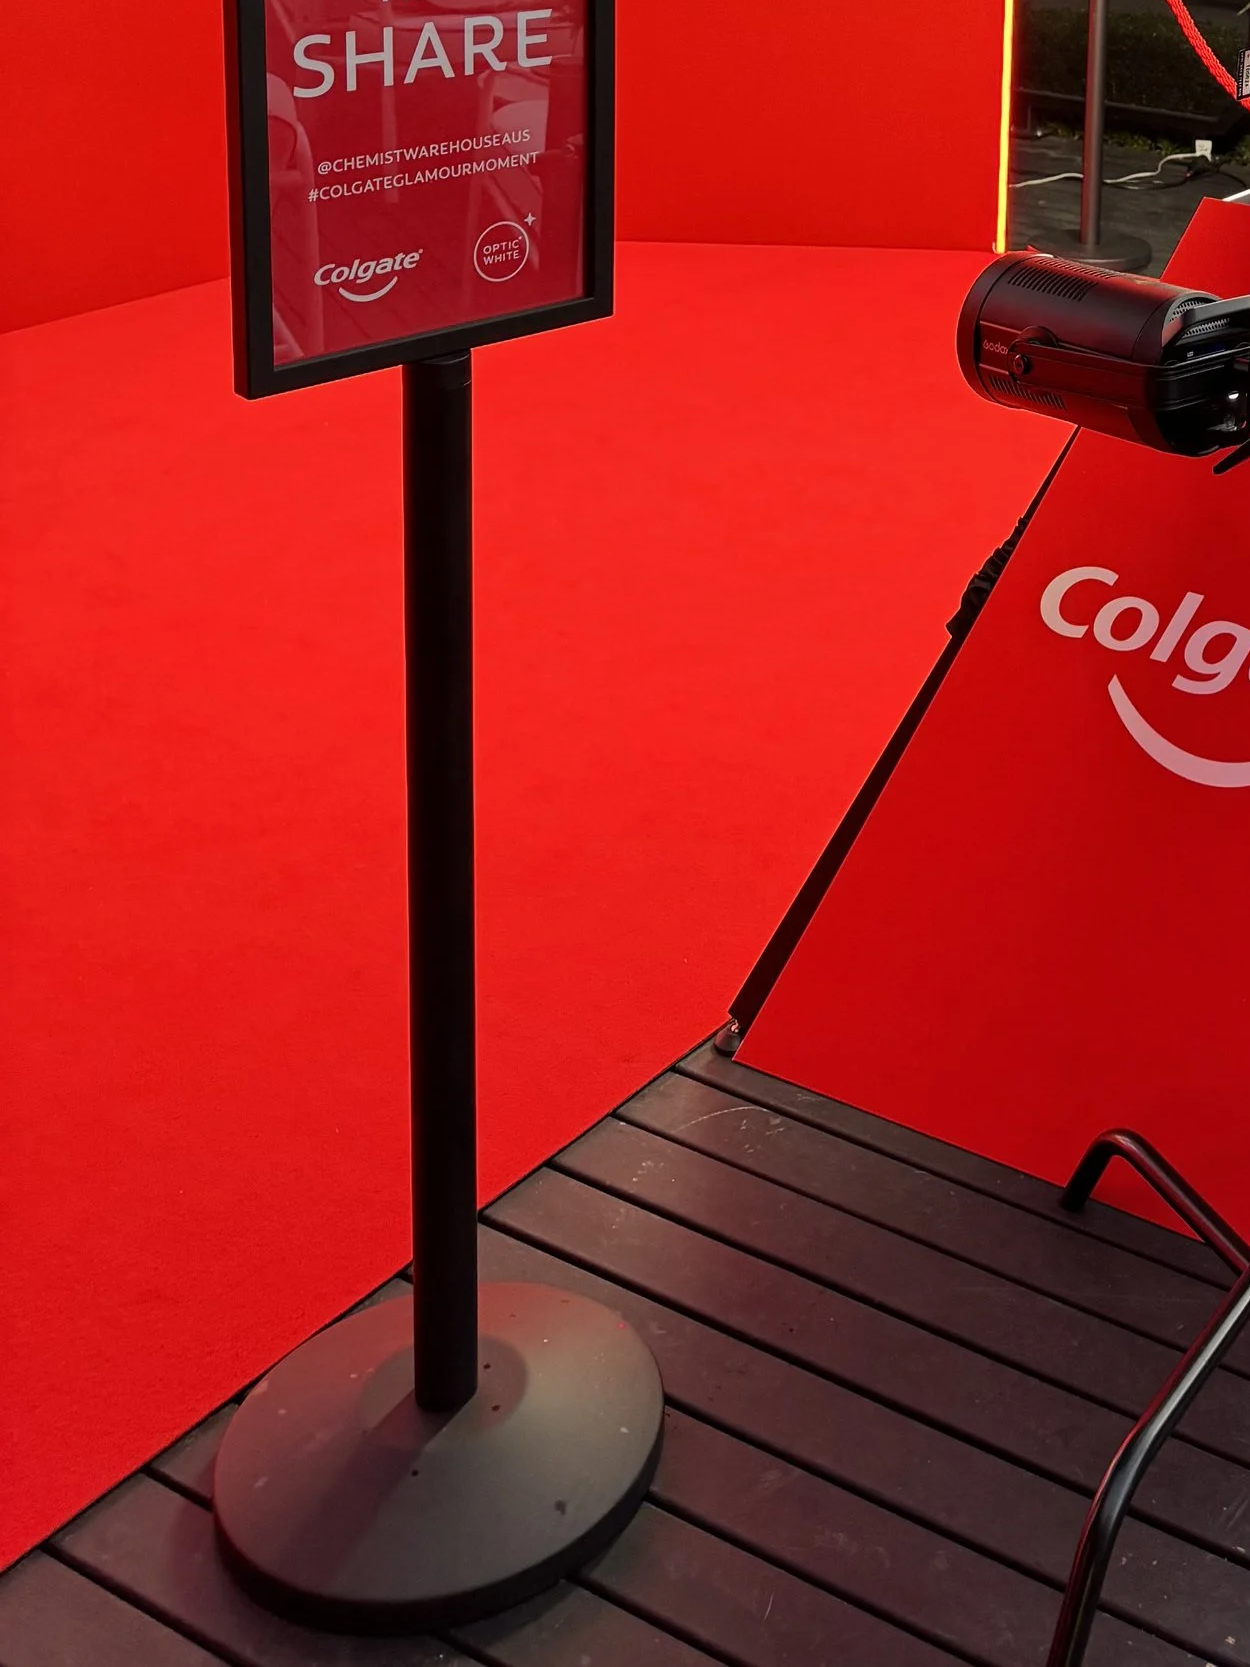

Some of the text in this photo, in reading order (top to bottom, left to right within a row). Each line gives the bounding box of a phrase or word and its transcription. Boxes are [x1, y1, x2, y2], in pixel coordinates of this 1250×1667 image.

[293, 8, 553, 98] SHARE
[317, 129, 531, 175] @CHEMISTWAREHOUSEAUS
[308, 151, 540, 202] #COLGATEGLAMOURMOMENT
[483, 239, 520, 254] OPTIC
[483, 250, 521, 265] WHITE
[313, 250, 421, 285] Colgate
